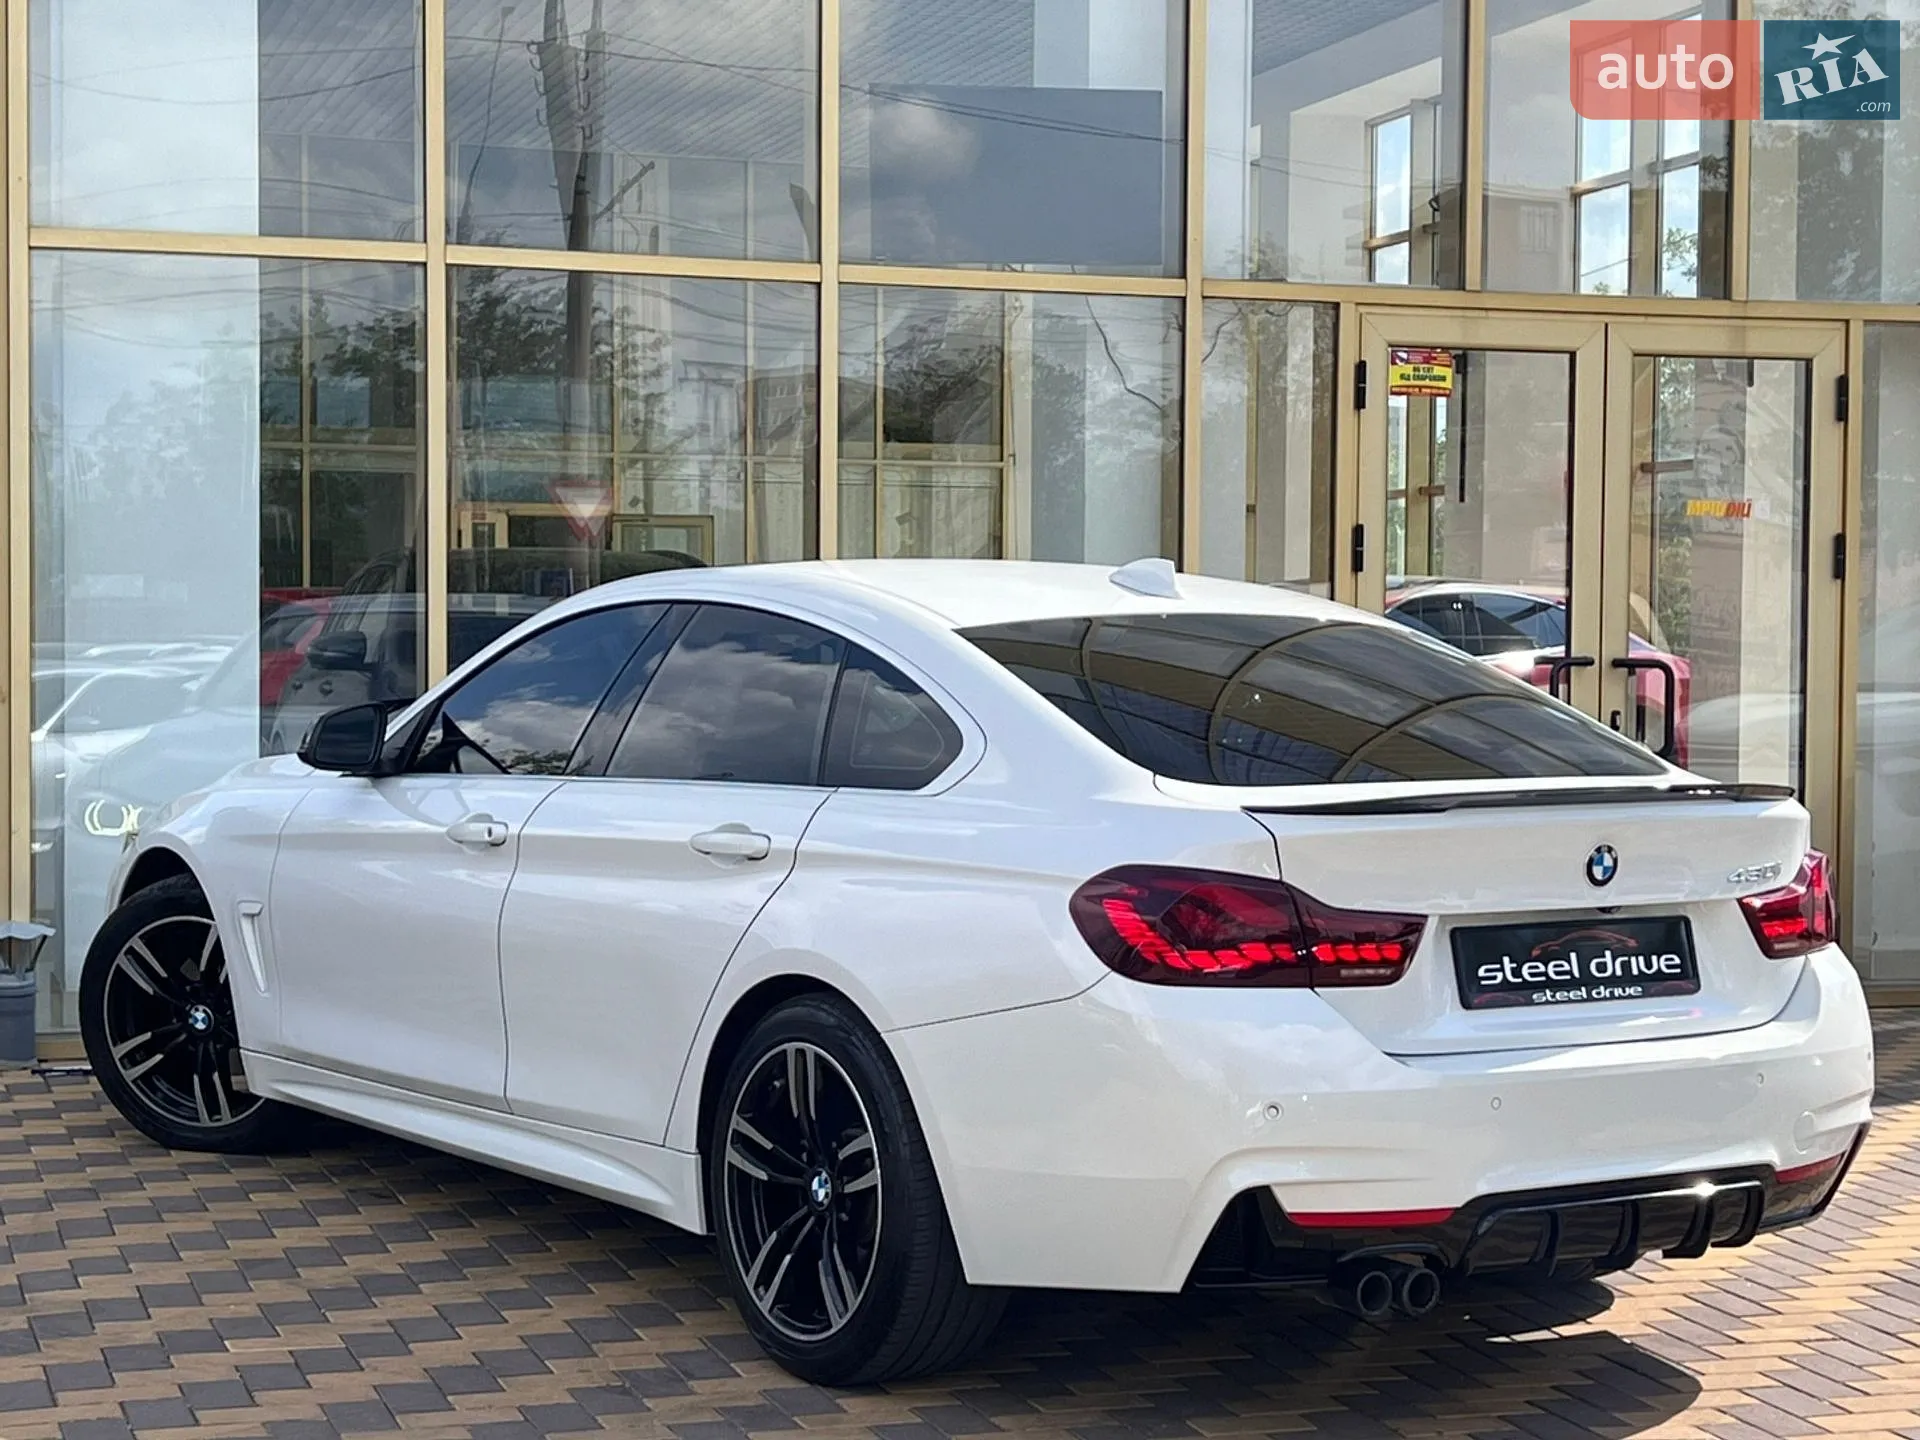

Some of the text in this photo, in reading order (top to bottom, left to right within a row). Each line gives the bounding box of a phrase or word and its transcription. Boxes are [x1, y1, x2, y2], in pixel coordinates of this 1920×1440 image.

[1477, 950, 1682, 985] steel drive
[1532, 984, 1643, 1003] steel drive
